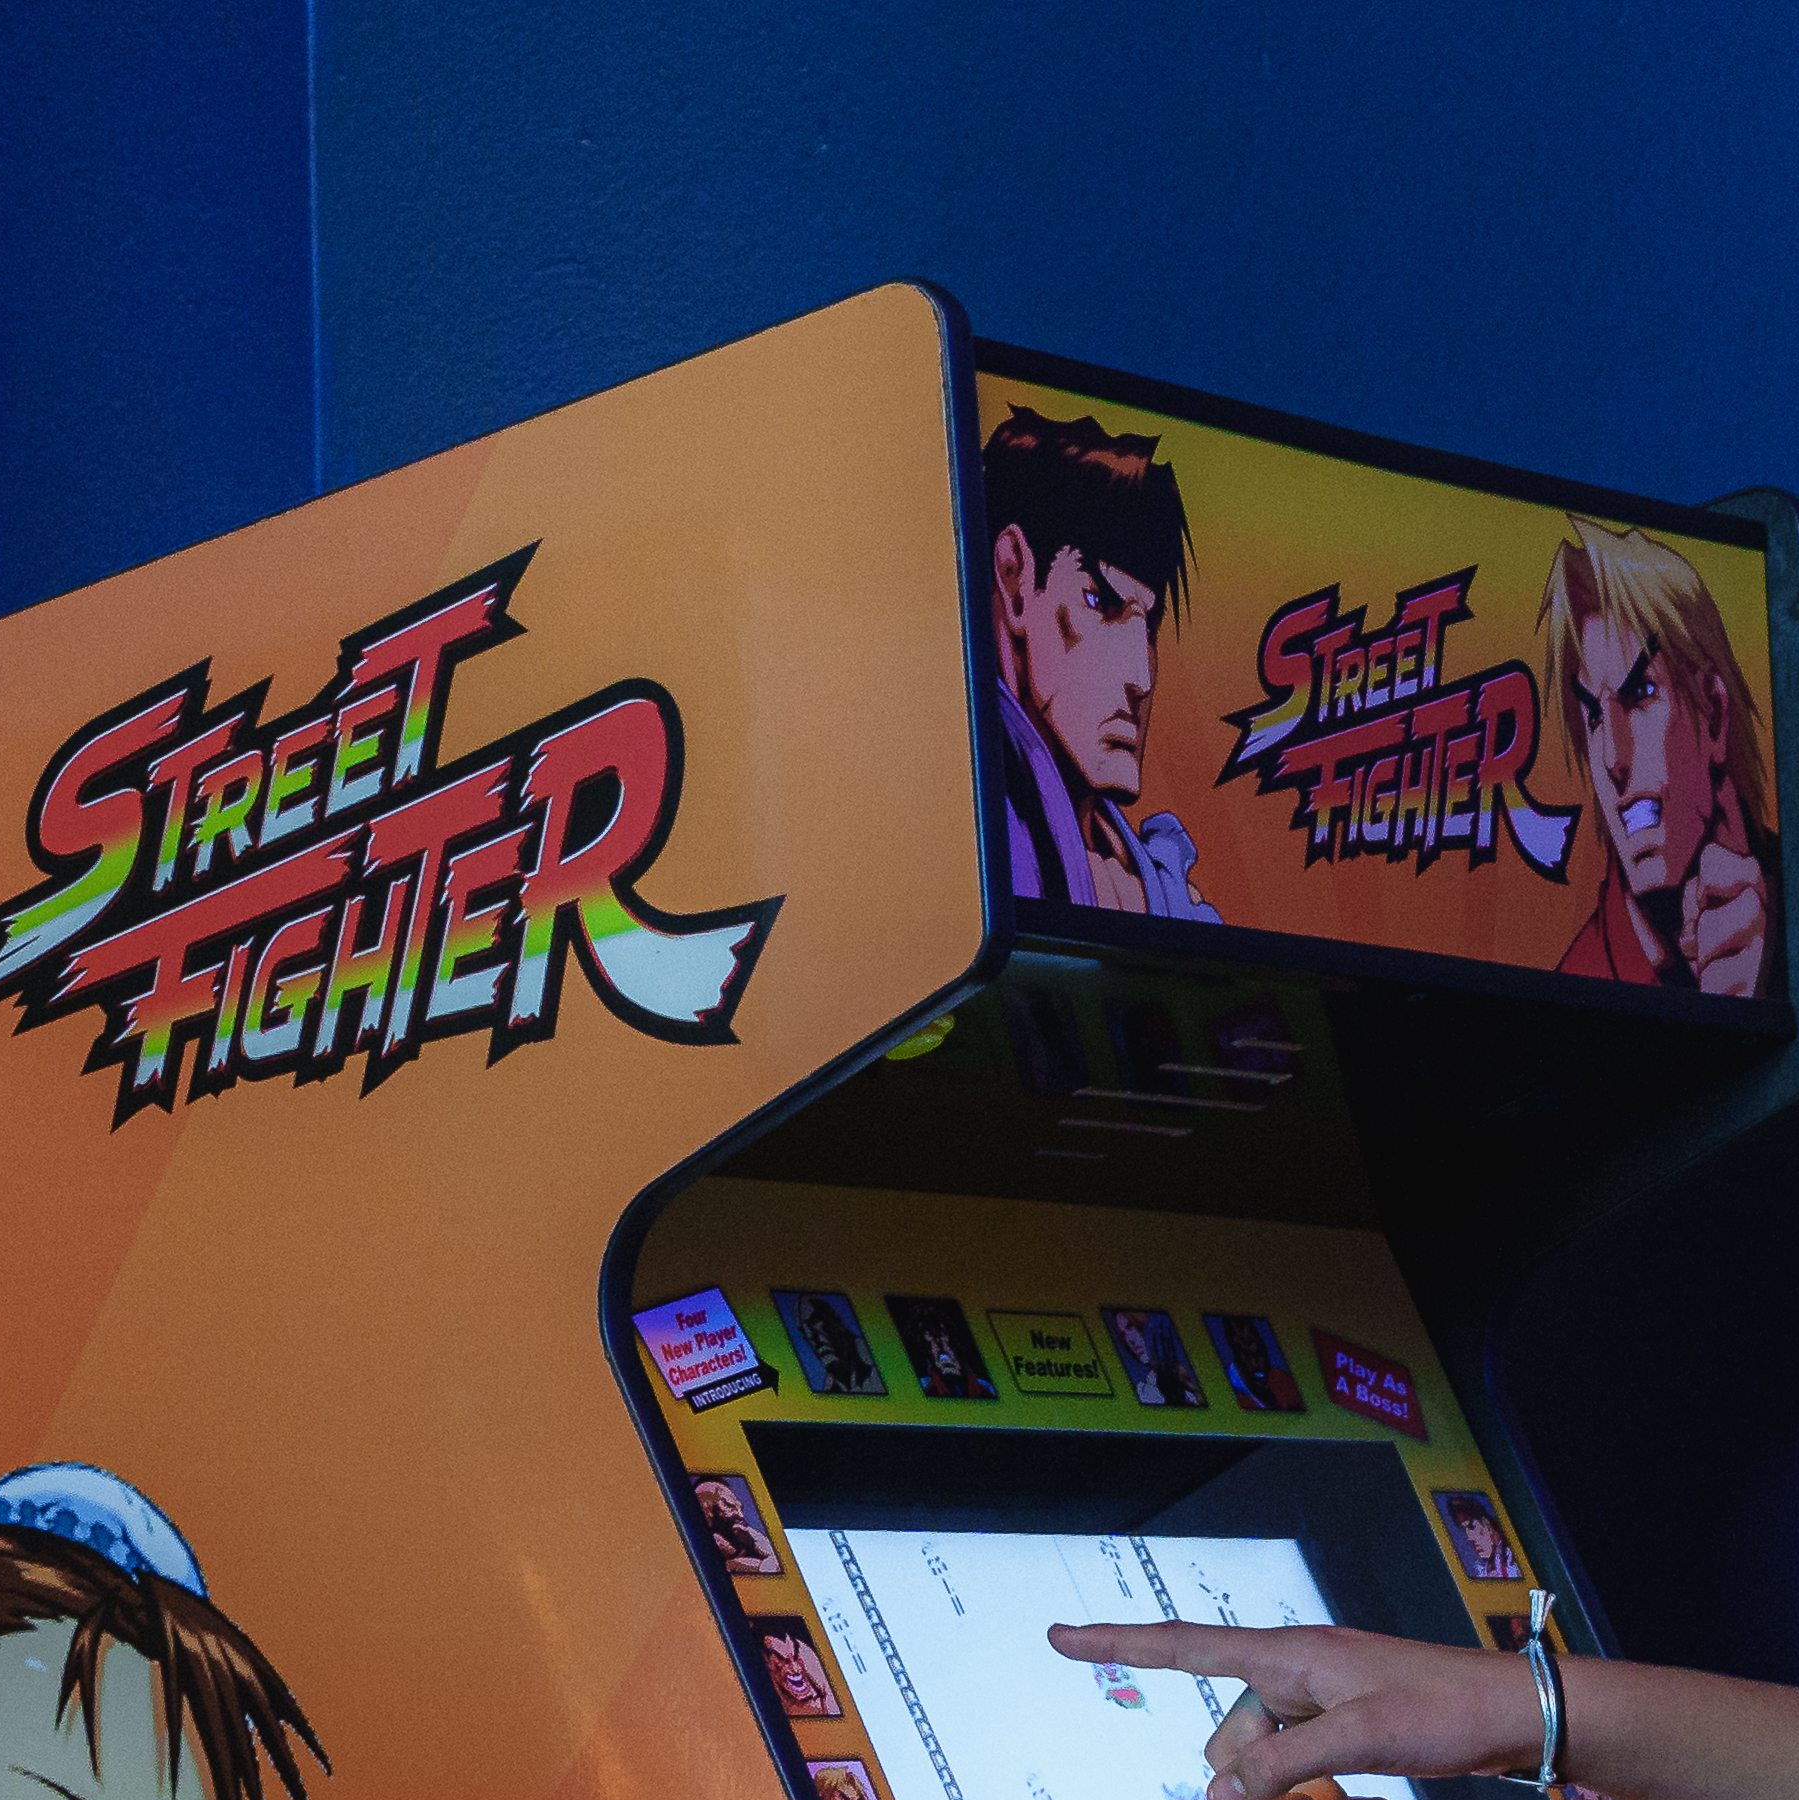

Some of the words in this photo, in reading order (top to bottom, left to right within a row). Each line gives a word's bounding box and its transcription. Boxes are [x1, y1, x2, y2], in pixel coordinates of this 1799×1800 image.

[1230, 574, 1468, 768] STREET
[1270, 665, 1576, 876] FIGHTER
[38, 688, 772, 1105] FIGHTER
[674, 1309, 707, 1332] Four
[1030, 1329, 1072, 1352] New
[660, 1340, 694, 1363] New
[694, 1325, 737, 1351] Player
[667, 1343, 748, 1386] Characters!
[1013, 1355, 1099, 1380] Features!
[1335, 1351, 1378, 1387] Play
[1383, 1373, 1407, 1397] As
[691, 1372, 763, 1409] INTRODUCING
[1336, 1375, 1350, 1395] A
[1356, 1383, 1408, 1419] Boss!
